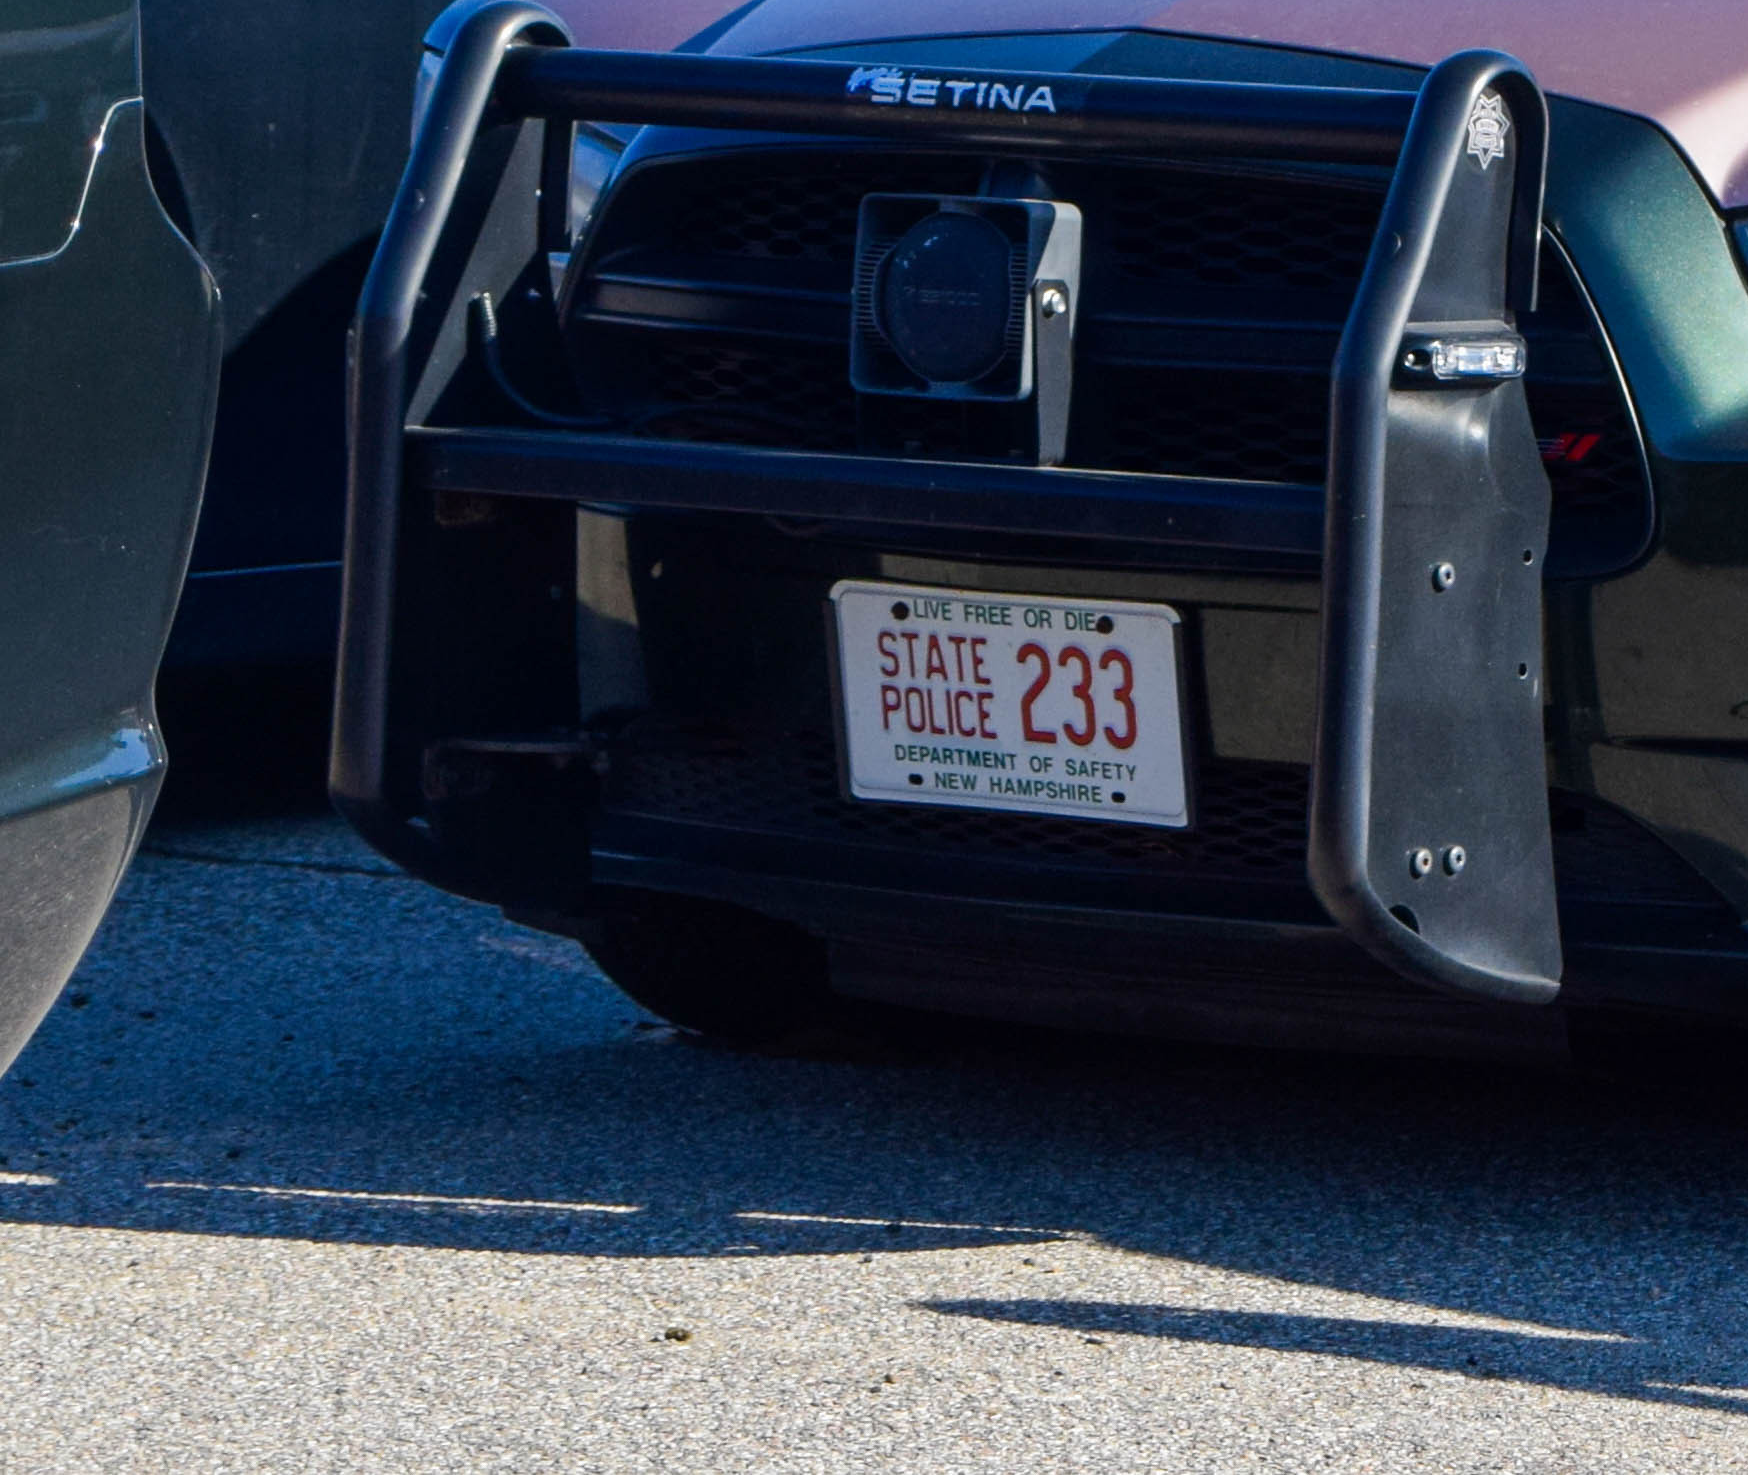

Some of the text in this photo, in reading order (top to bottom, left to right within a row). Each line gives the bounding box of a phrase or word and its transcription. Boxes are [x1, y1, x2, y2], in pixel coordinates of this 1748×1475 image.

[870, 77, 1057, 113] SETINA
[913, 599, 1097, 632] LIVE FREE OR DIE
[877, 630, 991, 685] STATE
[880, 684, 998, 740] POLICE
[1015, 642, 1138, 750] 233
[894, 744, 1138, 782] DEPARTMENT OF SAFETY
[934, 772, 1103, 803] NEW HAMPSHIRE
